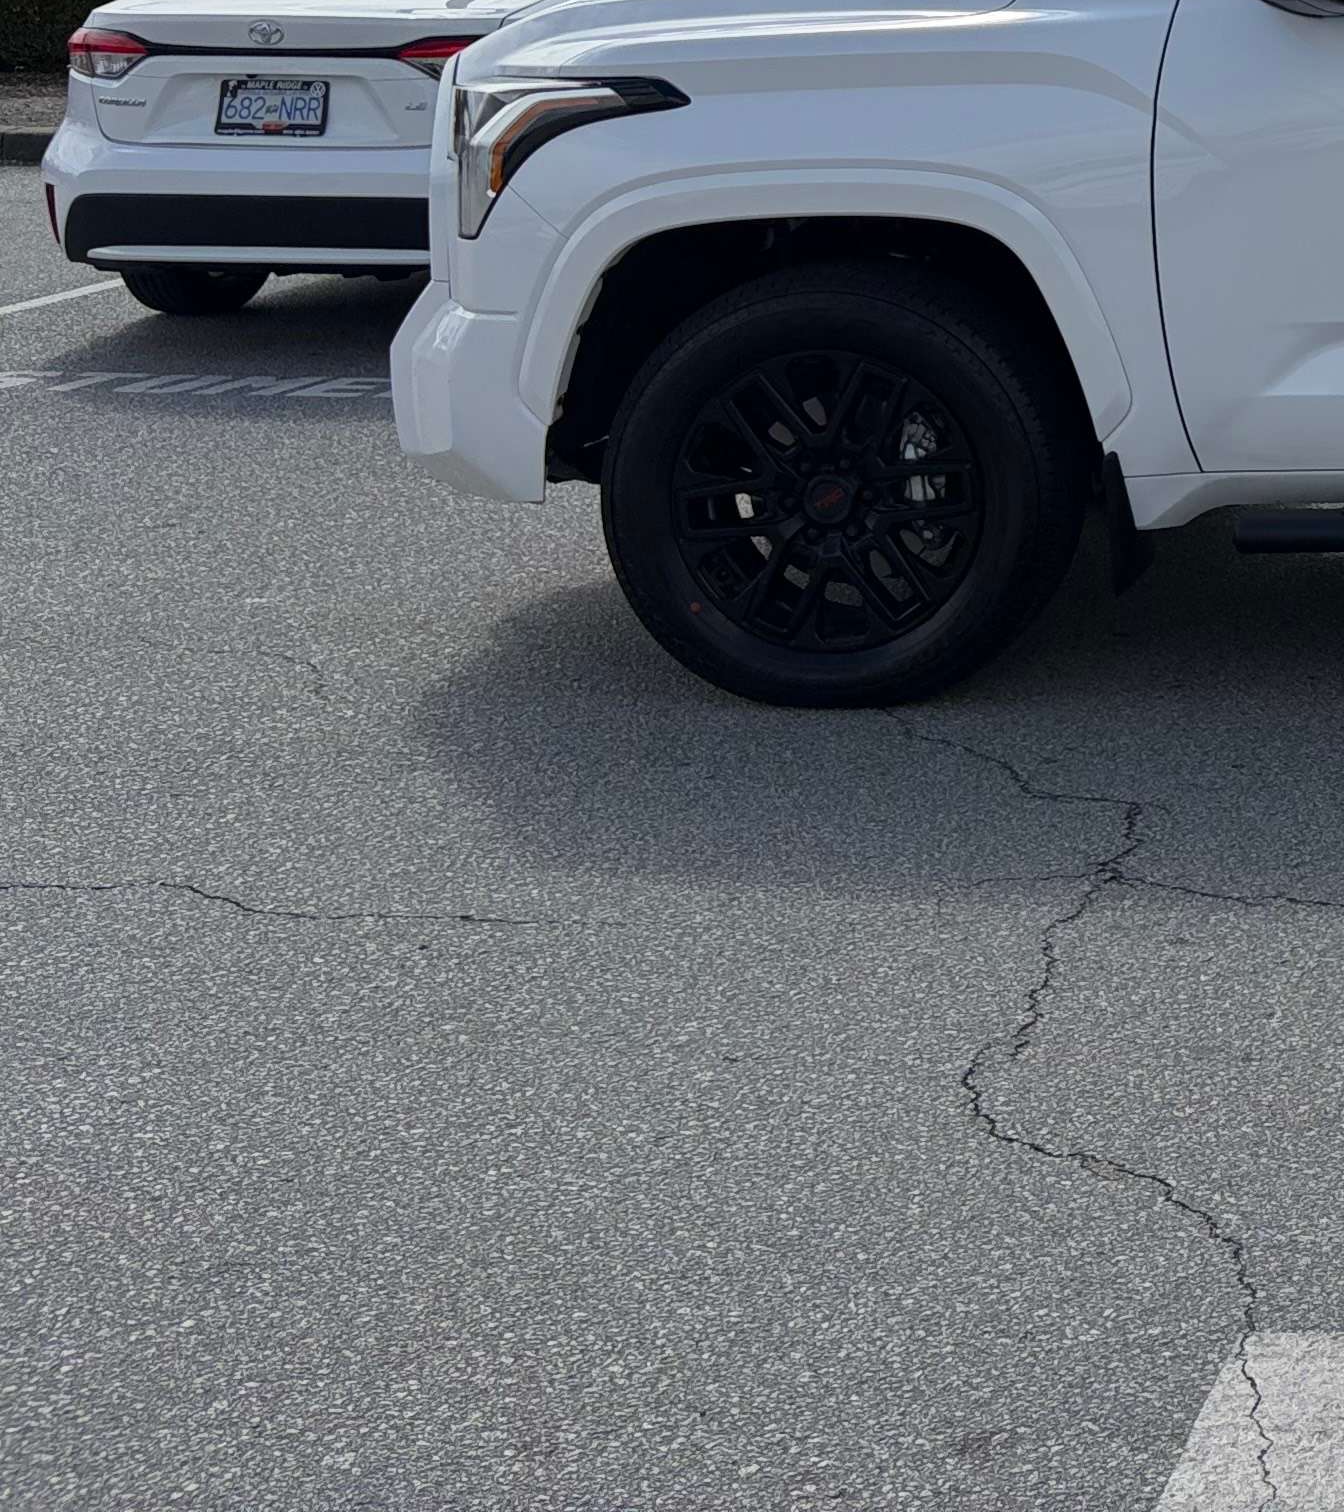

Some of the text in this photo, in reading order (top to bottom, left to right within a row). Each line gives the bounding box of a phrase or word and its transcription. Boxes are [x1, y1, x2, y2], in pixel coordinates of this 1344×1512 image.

[246, 80, 275, 89] MAPLE
[224, 95, 321, 121] 682 NRR
